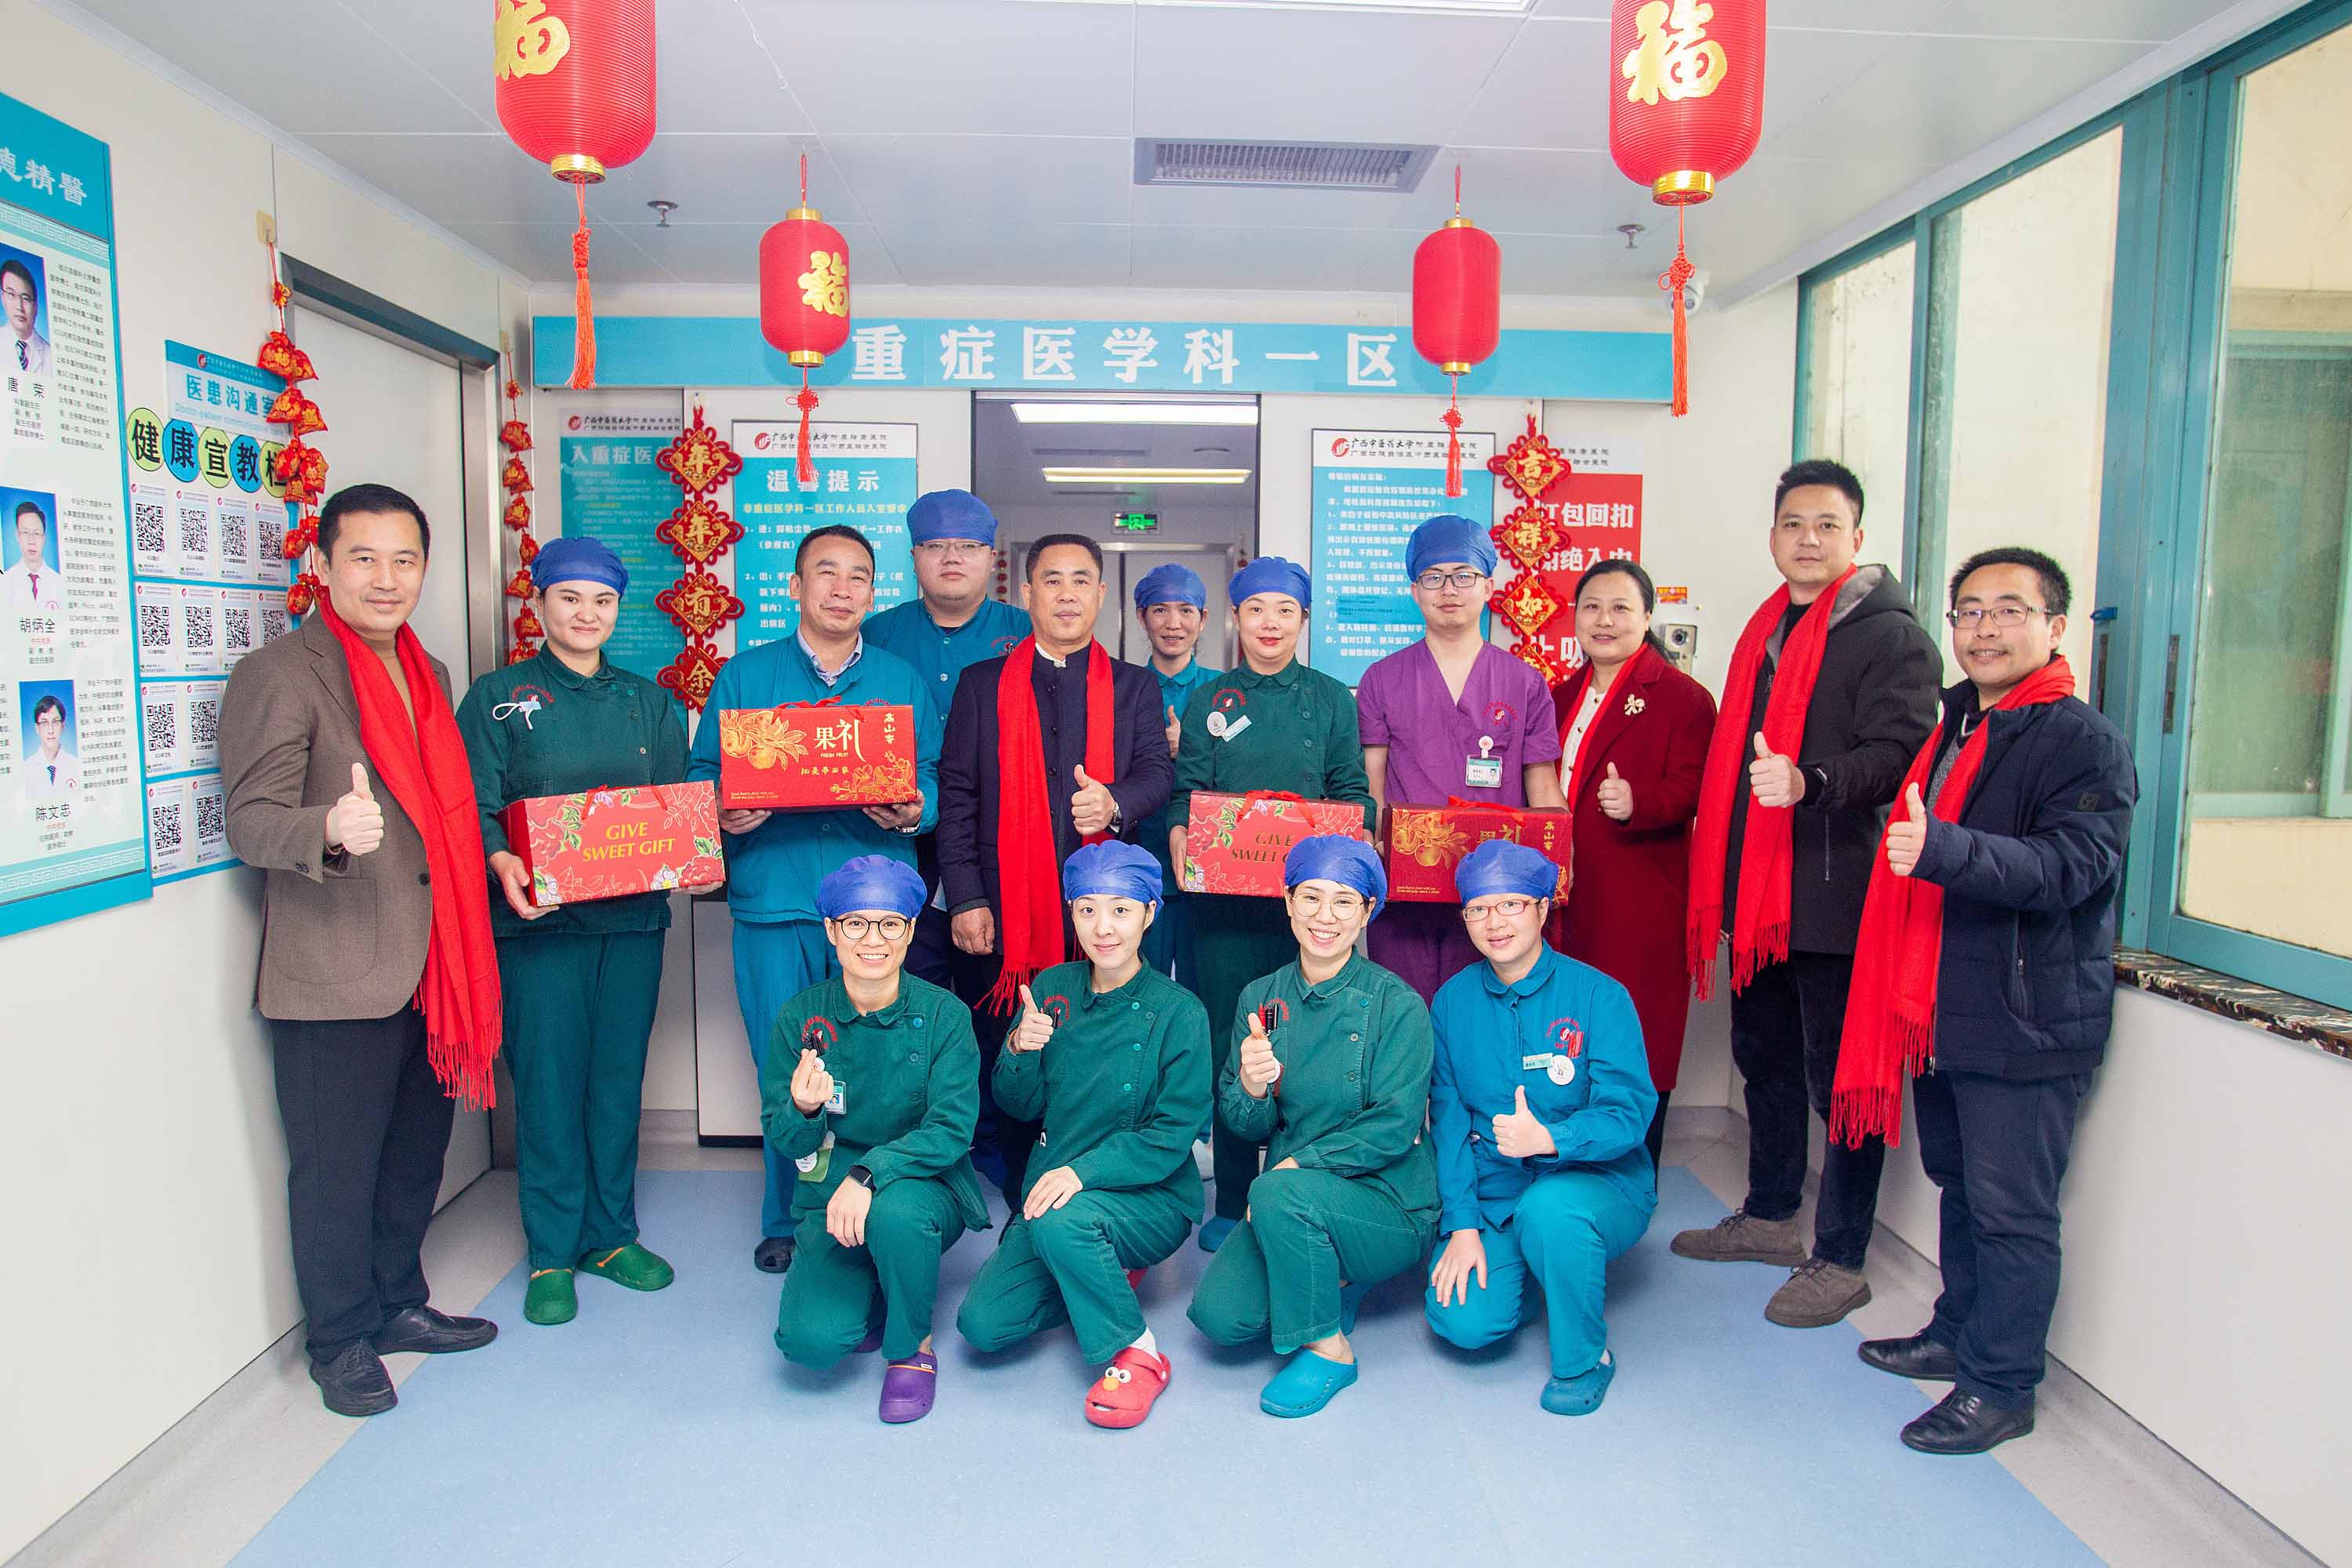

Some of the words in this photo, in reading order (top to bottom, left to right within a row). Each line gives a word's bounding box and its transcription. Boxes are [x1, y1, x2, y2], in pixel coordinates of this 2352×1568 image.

[1622, 0, 1727, 105] 福
[798, 251, 849, 318] 福
[851, 325, 1399, 387] 重症医学科一区
[605, 821, 649, 841] GIVE
[1254, 833, 1294, 847] GIVE
[583, 842, 636, 862] SWEET
[639, 837, 677, 855] GIFT
[1230, 848, 1279, 864] SWEET
